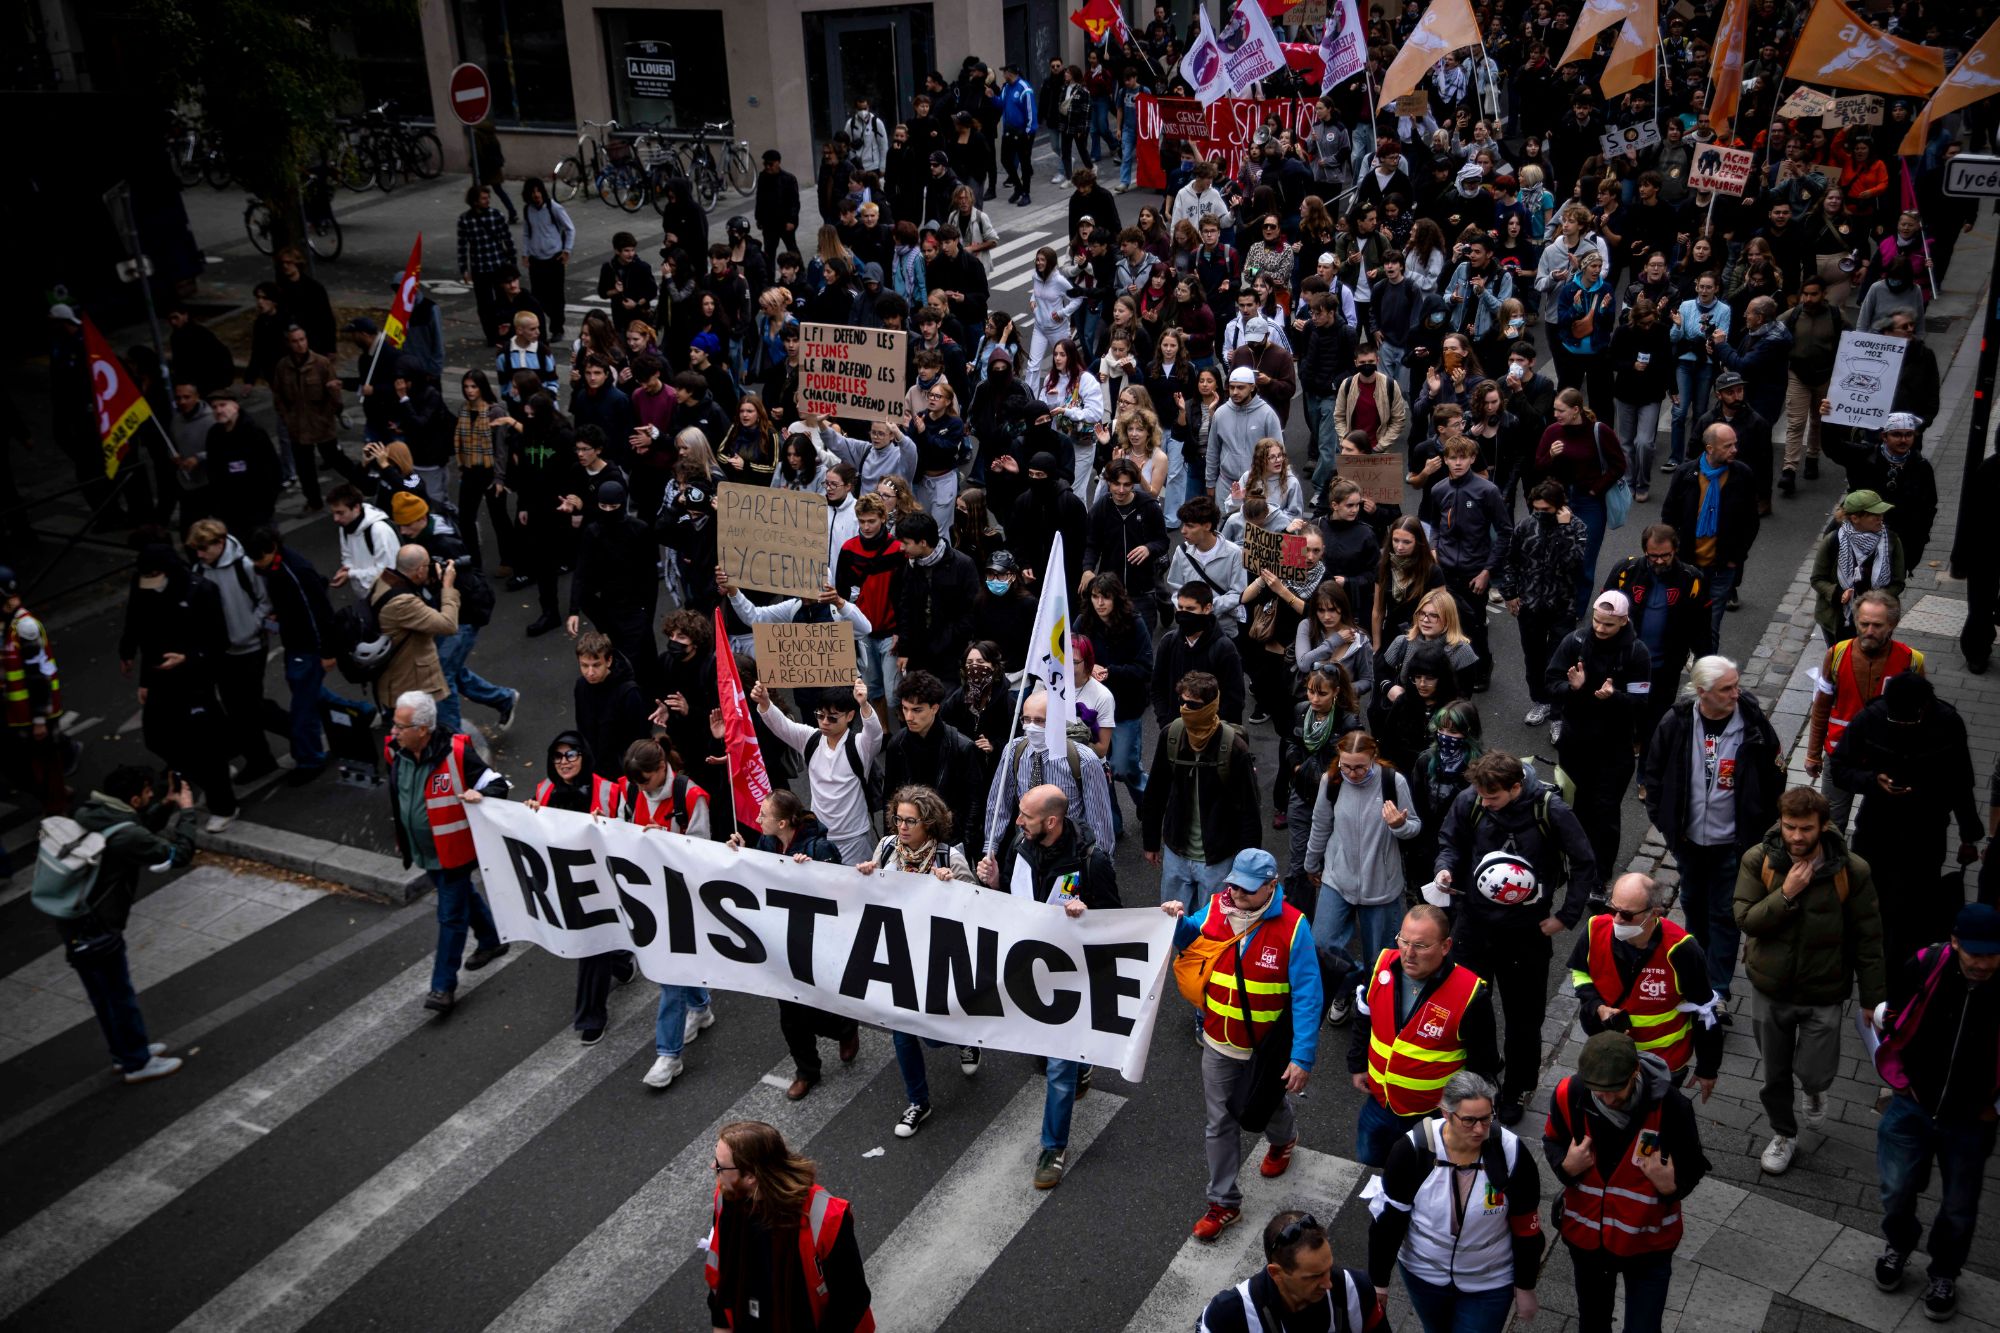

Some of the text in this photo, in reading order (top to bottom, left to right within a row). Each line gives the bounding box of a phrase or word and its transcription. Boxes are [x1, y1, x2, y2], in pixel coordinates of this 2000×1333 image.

[631, 61, 672, 75] A LOUER
[1842, 114, 1866, 125] PAS
[1957, 170, 2000, 190] lycé
[804, 327, 894, 350] LFI DEFEND LES
[805, 343, 849, 359] JEUNES
[1864, 350, 1883, 358] MOI
[804, 358, 895, 383] LE RN DEFEND LES
[806, 373, 867, 396] POUBELLES
[803, 388, 904, 417] CHACUNS DEFEND LES
[1850, 392, 1870, 403] CES
[807, 400, 837, 416] SIENS
[1835, 403, 1884, 418] POULETS
[724, 490, 827, 534] PARENTS
[726, 525, 746, 537] AUX
[771, 624, 798, 638] QUI
[767, 638, 846, 653] L'IGNORANCE
[778, 652, 835, 667] RÉCOLTE
[758, 669, 777, 684] LA
[502, 836, 1149, 1036] RESISTANCE
[1640, 980, 1667, 997] cgt
[1423, 1022, 1444, 1037] cgt
